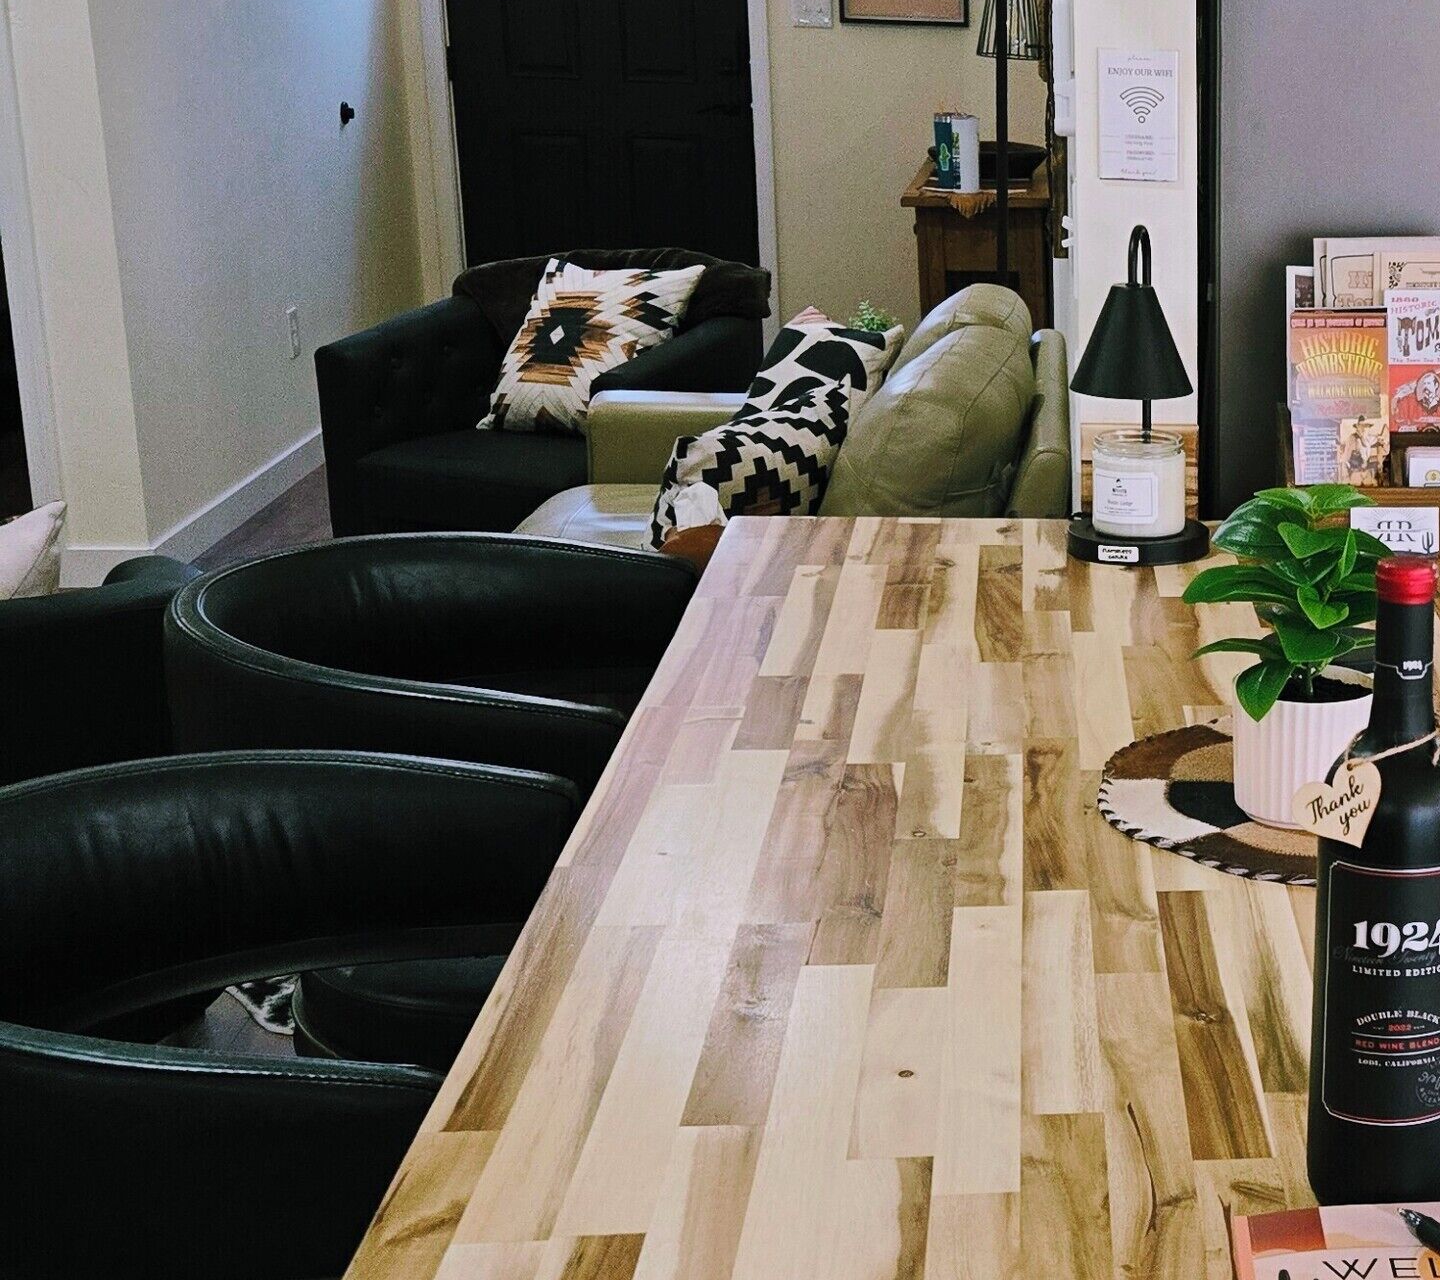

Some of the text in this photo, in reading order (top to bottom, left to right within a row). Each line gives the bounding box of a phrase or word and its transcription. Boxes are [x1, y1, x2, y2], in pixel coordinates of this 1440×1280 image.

[1108, 66, 1174, 78] ENJOY OUR WIFI
[1391, 300, 1437, 315] HISTORIC
[1299, 331, 1380, 360] HISTORIC
[1295, 352, 1384, 381] TOMBSTONE
[1305, 774, 1365, 825] Thank
[1340, 799, 1371, 837] you
[1352, 965, 1401, 977] LIMITED
[1356, 1010, 1440, 1026] DOUBLE BLACK
[1355, 1037, 1440, 1050] RED WINE BLEND
[1384, 1056, 1436, 1067] CALIFORNIA
